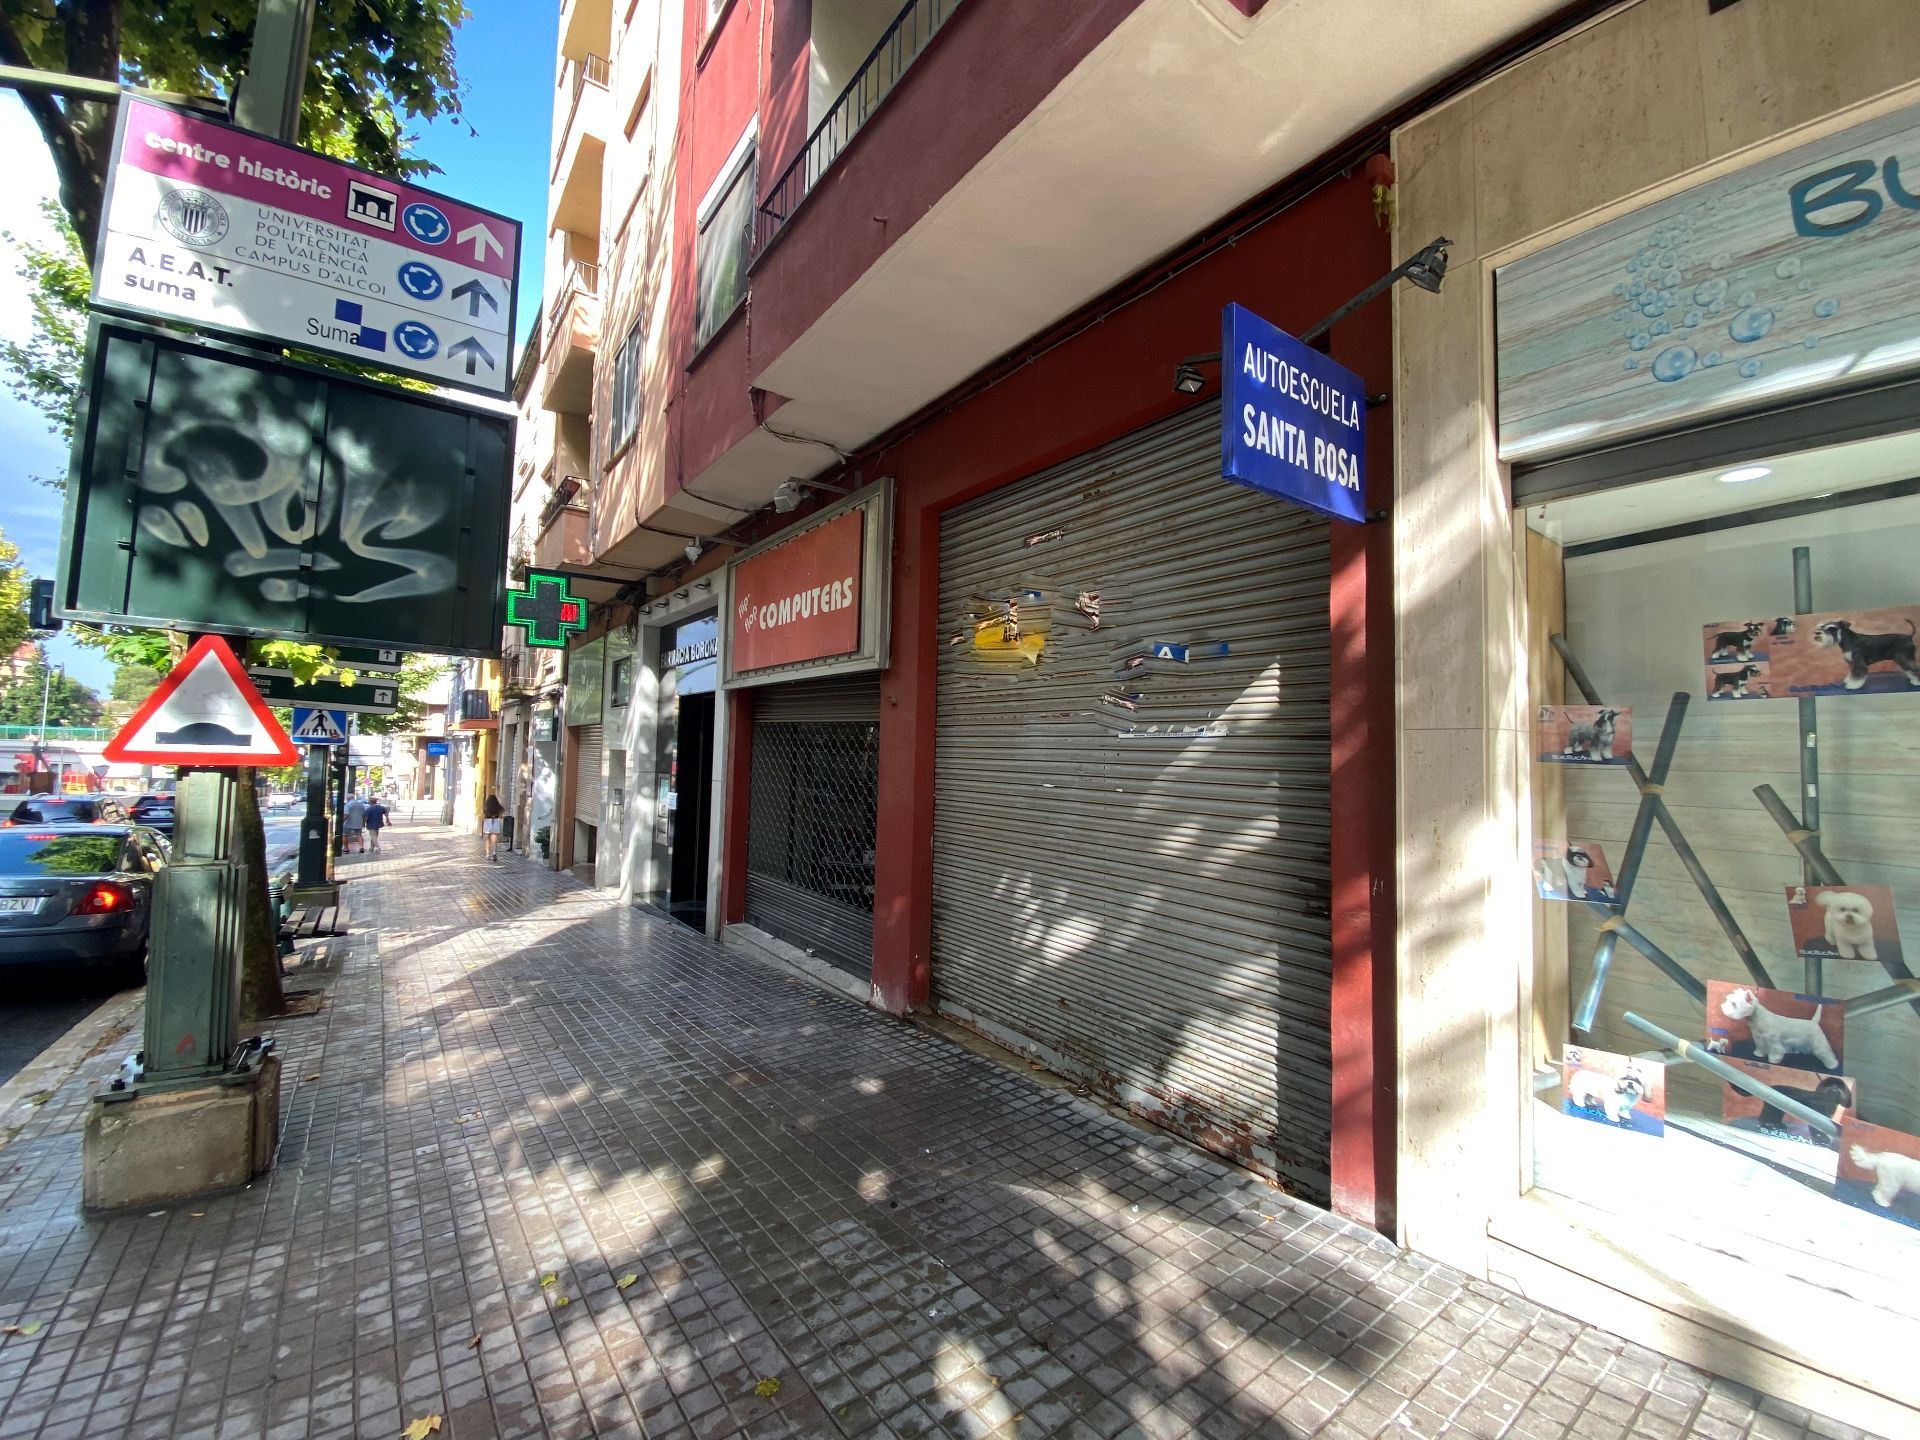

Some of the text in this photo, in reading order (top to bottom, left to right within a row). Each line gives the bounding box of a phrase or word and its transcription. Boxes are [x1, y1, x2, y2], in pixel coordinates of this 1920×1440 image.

[144, 131, 333, 200] centre històric
[256, 221, 369, 263] POLITÈCNICA
[258, 207, 370, 249] UNIVERSITAT
[128, 247, 234, 287] A.E.A.T.
[235, 246, 387, 296] CAMPUS D'ALCOI
[255, 234, 368, 276] DE VALÈNCIA
[124, 272, 197, 301] suma
[306, 317, 360, 346] Suma
[1243, 342, 1360, 432] AUTOESCUELA
[1243, 403, 1360, 492] SANTA ROSA
[759, 576, 853, 631] COMPUTERS
